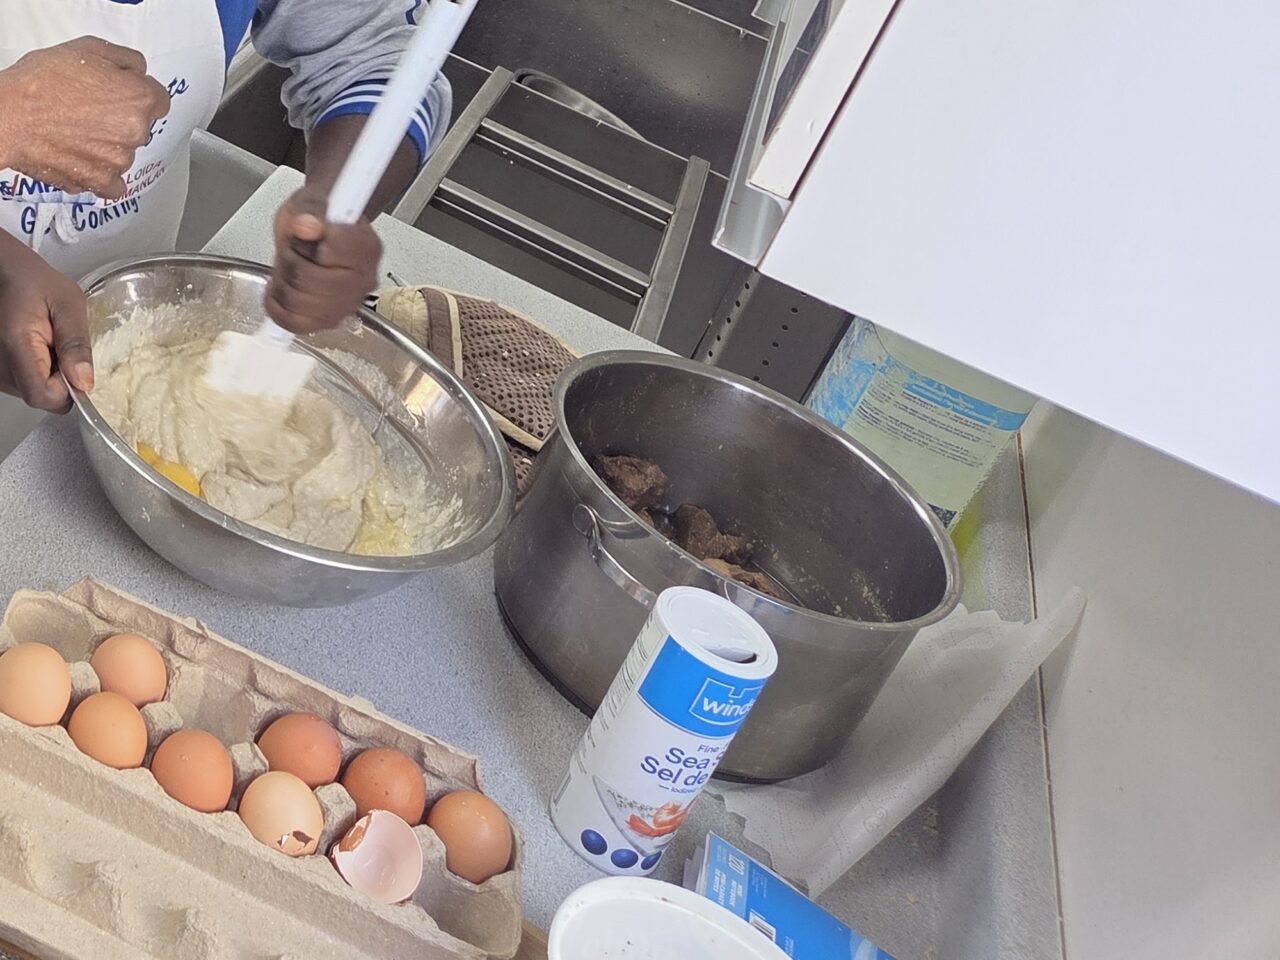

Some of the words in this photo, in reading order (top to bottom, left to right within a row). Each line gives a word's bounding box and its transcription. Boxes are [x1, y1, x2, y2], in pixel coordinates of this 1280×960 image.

[702, 696, 757, 718] wind
[664, 747, 711, 770] Sea
[696, 743, 720, 754] Fine
[640, 755, 683, 784] Sel
[684, 771, 708, 786] de
[729, 854, 745, 876] 120
